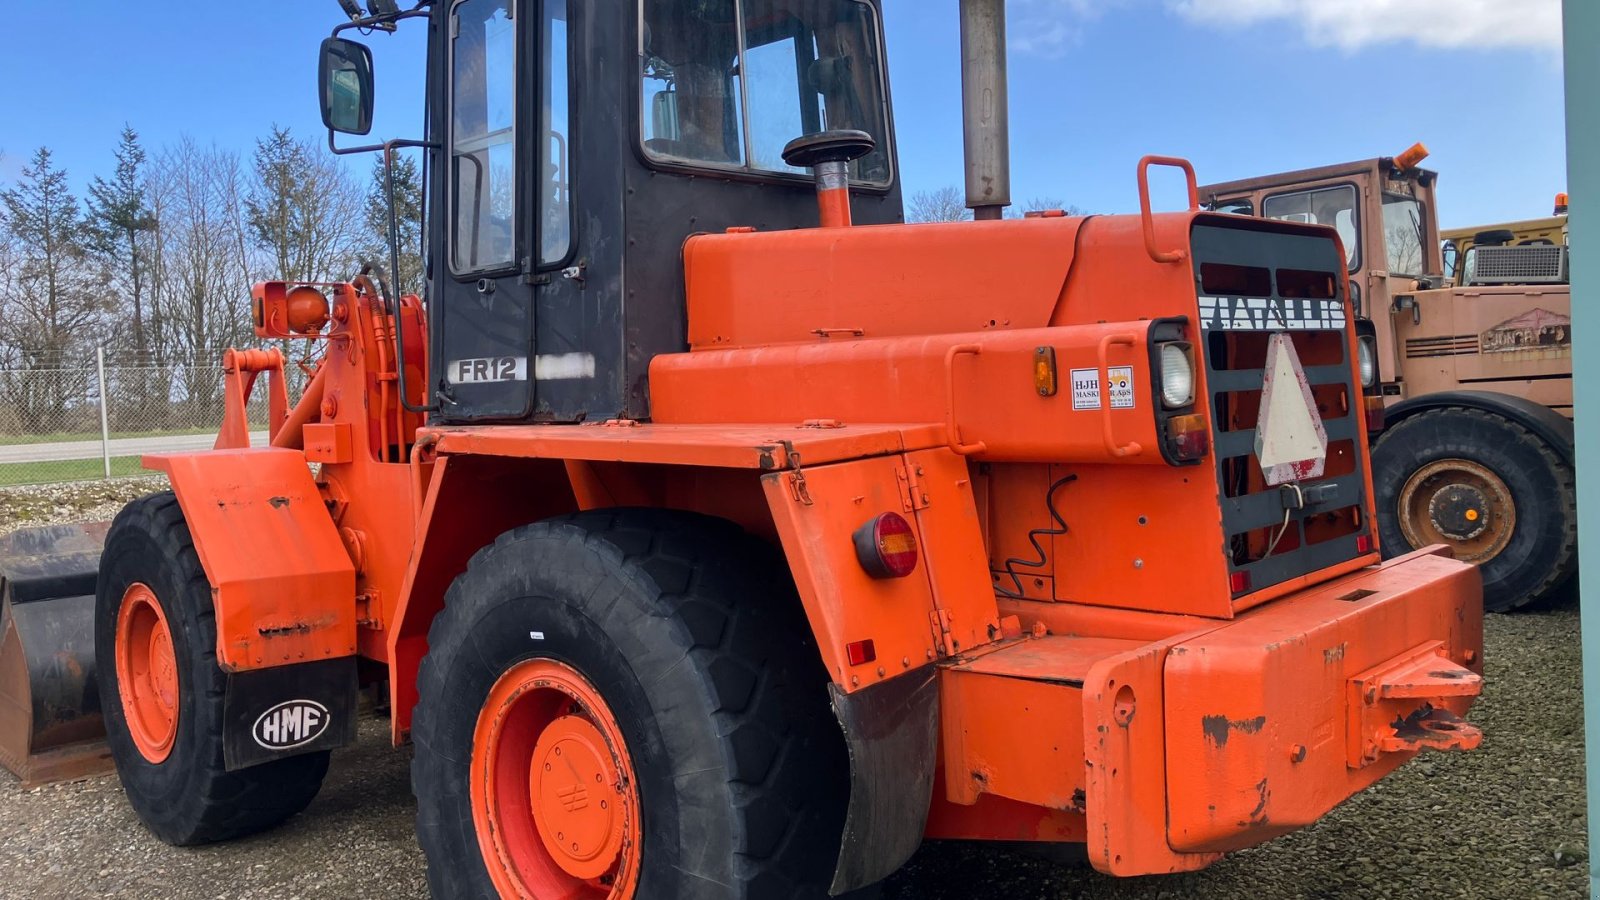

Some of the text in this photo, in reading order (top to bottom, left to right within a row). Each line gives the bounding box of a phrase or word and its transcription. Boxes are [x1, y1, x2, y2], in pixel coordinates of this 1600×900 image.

[458, 357, 517, 382] FR12
[1075, 380, 1098, 390] HJH
[263, 706, 321, 743] HMF
